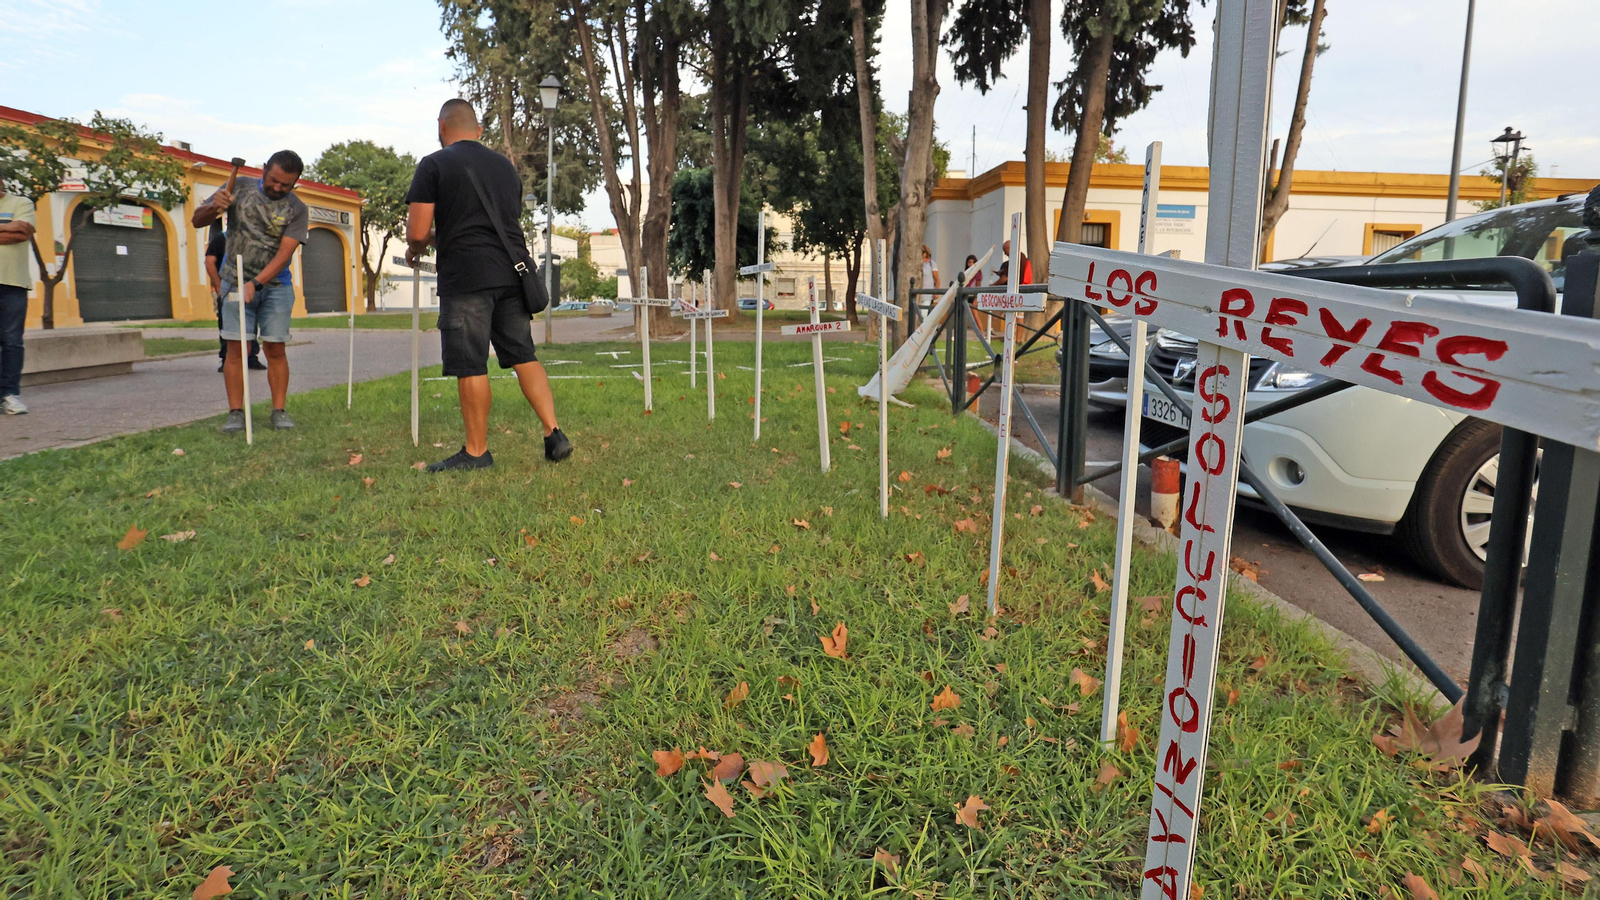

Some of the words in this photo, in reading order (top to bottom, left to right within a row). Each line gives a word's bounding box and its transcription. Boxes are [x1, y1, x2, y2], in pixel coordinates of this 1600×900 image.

[1139, 158, 1152, 244] CALLE
[1085, 261, 1158, 316] LOS
[836, 321, 842, 330] 2
[1215, 288, 1509, 411] REYES
[1151, 398, 1177, 422] 3326
[1163, 364, 1231, 785] SOLUCION
